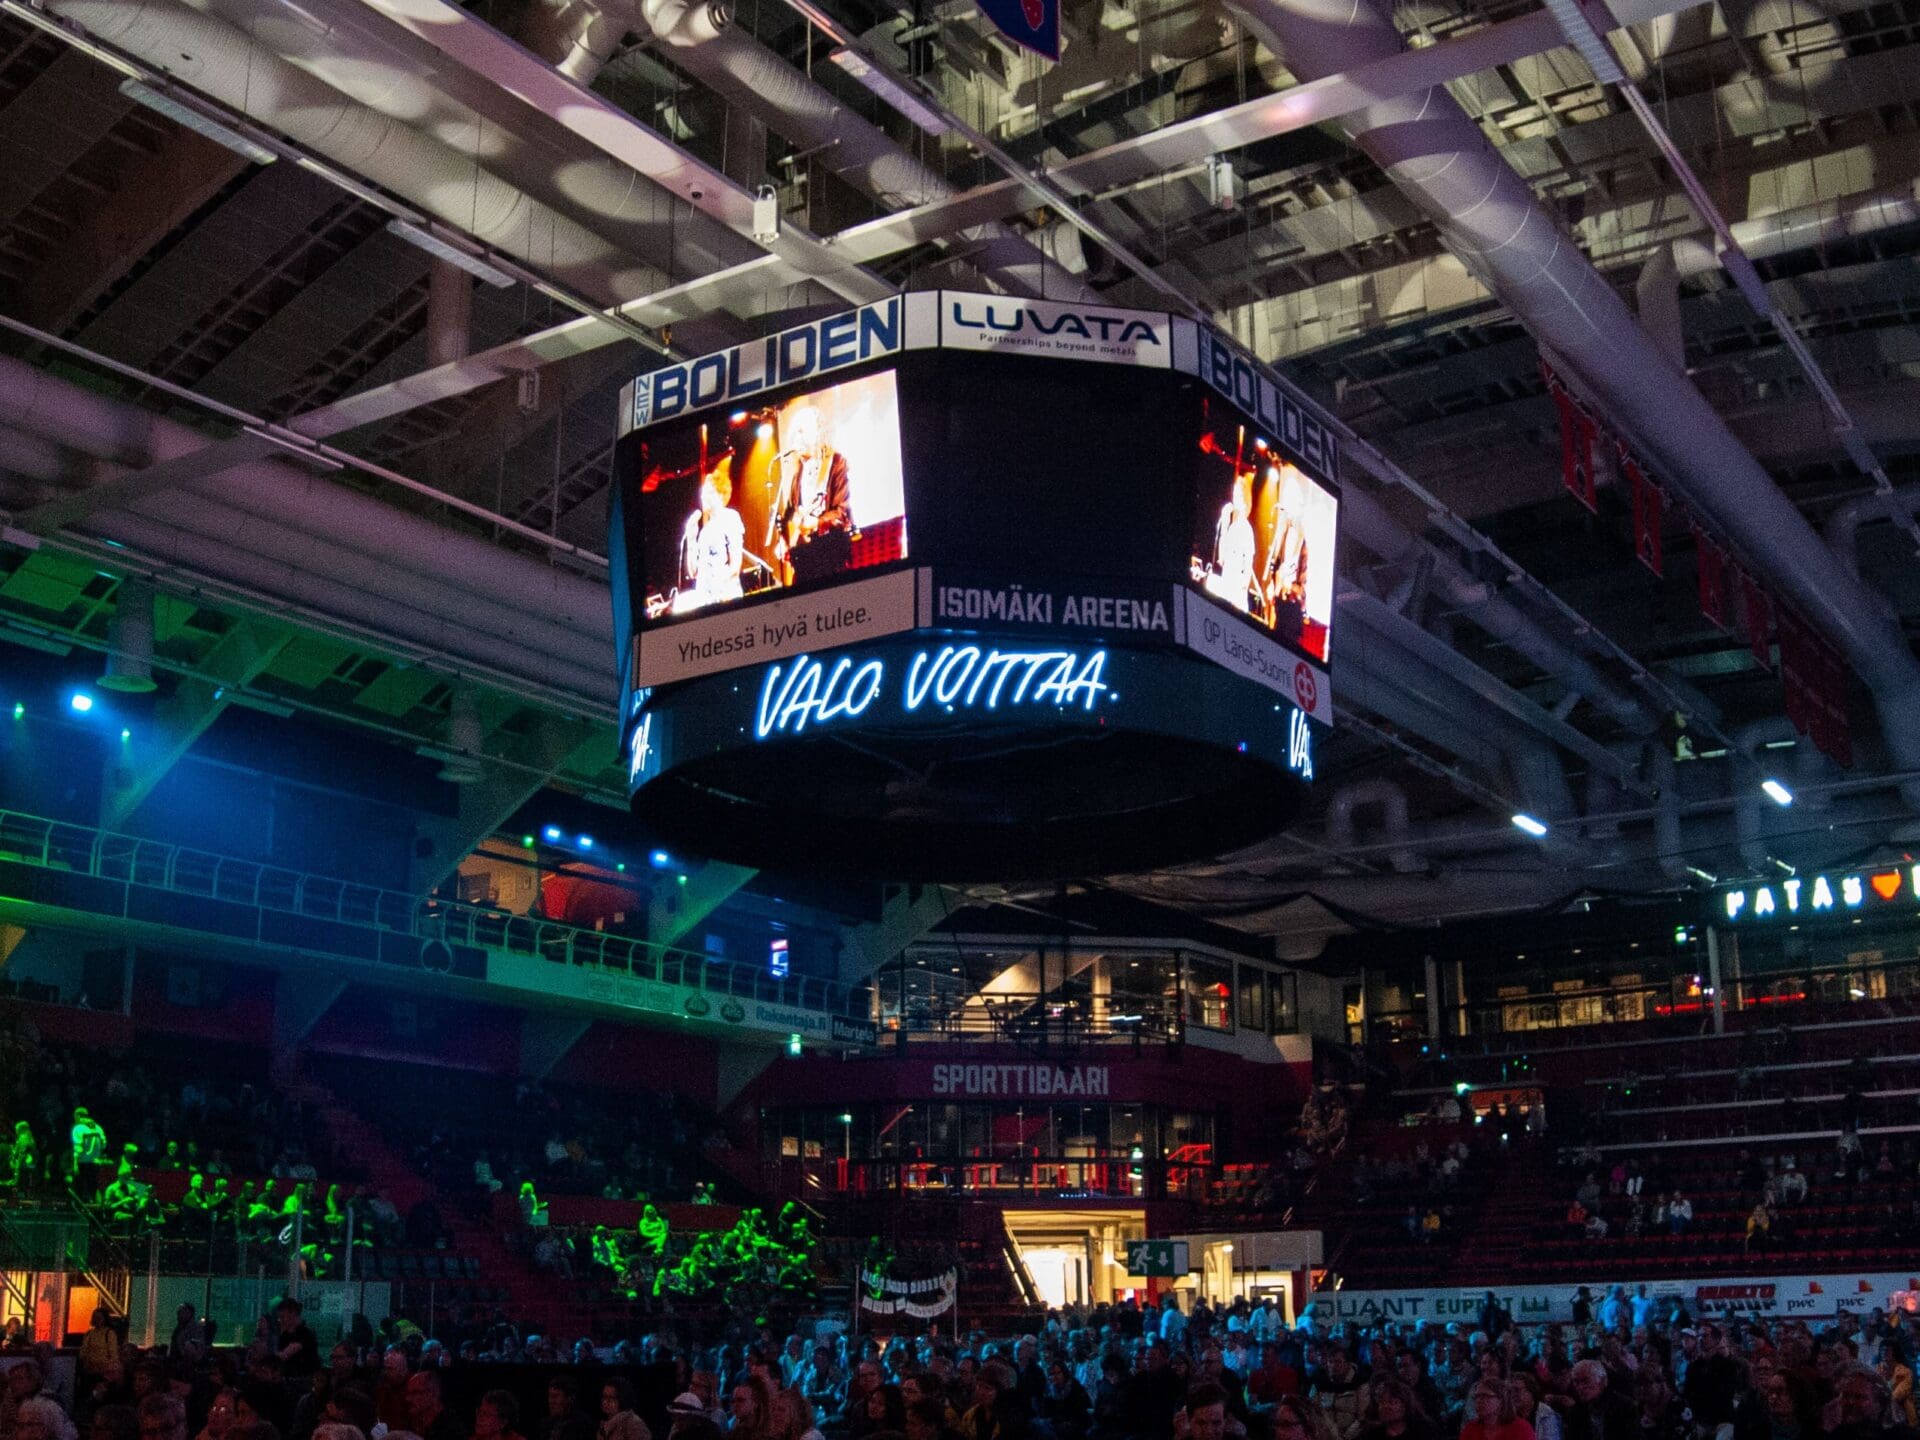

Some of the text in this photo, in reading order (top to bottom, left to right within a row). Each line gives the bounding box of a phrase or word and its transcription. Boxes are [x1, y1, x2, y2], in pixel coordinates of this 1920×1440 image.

[954, 303, 1161, 345] LUVATA
[980, 333, 1138, 356] Partnerships beyond metals
[652, 299, 899, 421] BOLIDEN
[636, 376, 650, 426] NEW
[1211, 337, 1340, 483] BOLIDEN
[939, 584, 1169, 631] ISOMÄKI AREENA
[678, 606, 872, 663] Yhdessä hyvä tulee.
[1204, 617, 1291, 688] OP Länsi-Suomi
[757, 646, 1119, 738] VALO VOITTAA.
[1726, 875, 1863, 918] PATAS
[933, 1064, 1109, 1095] SPORTTIBAARI
[1787, 1299, 1816, 1312] pwc
[1836, 1297, 1865, 1313] pwc
